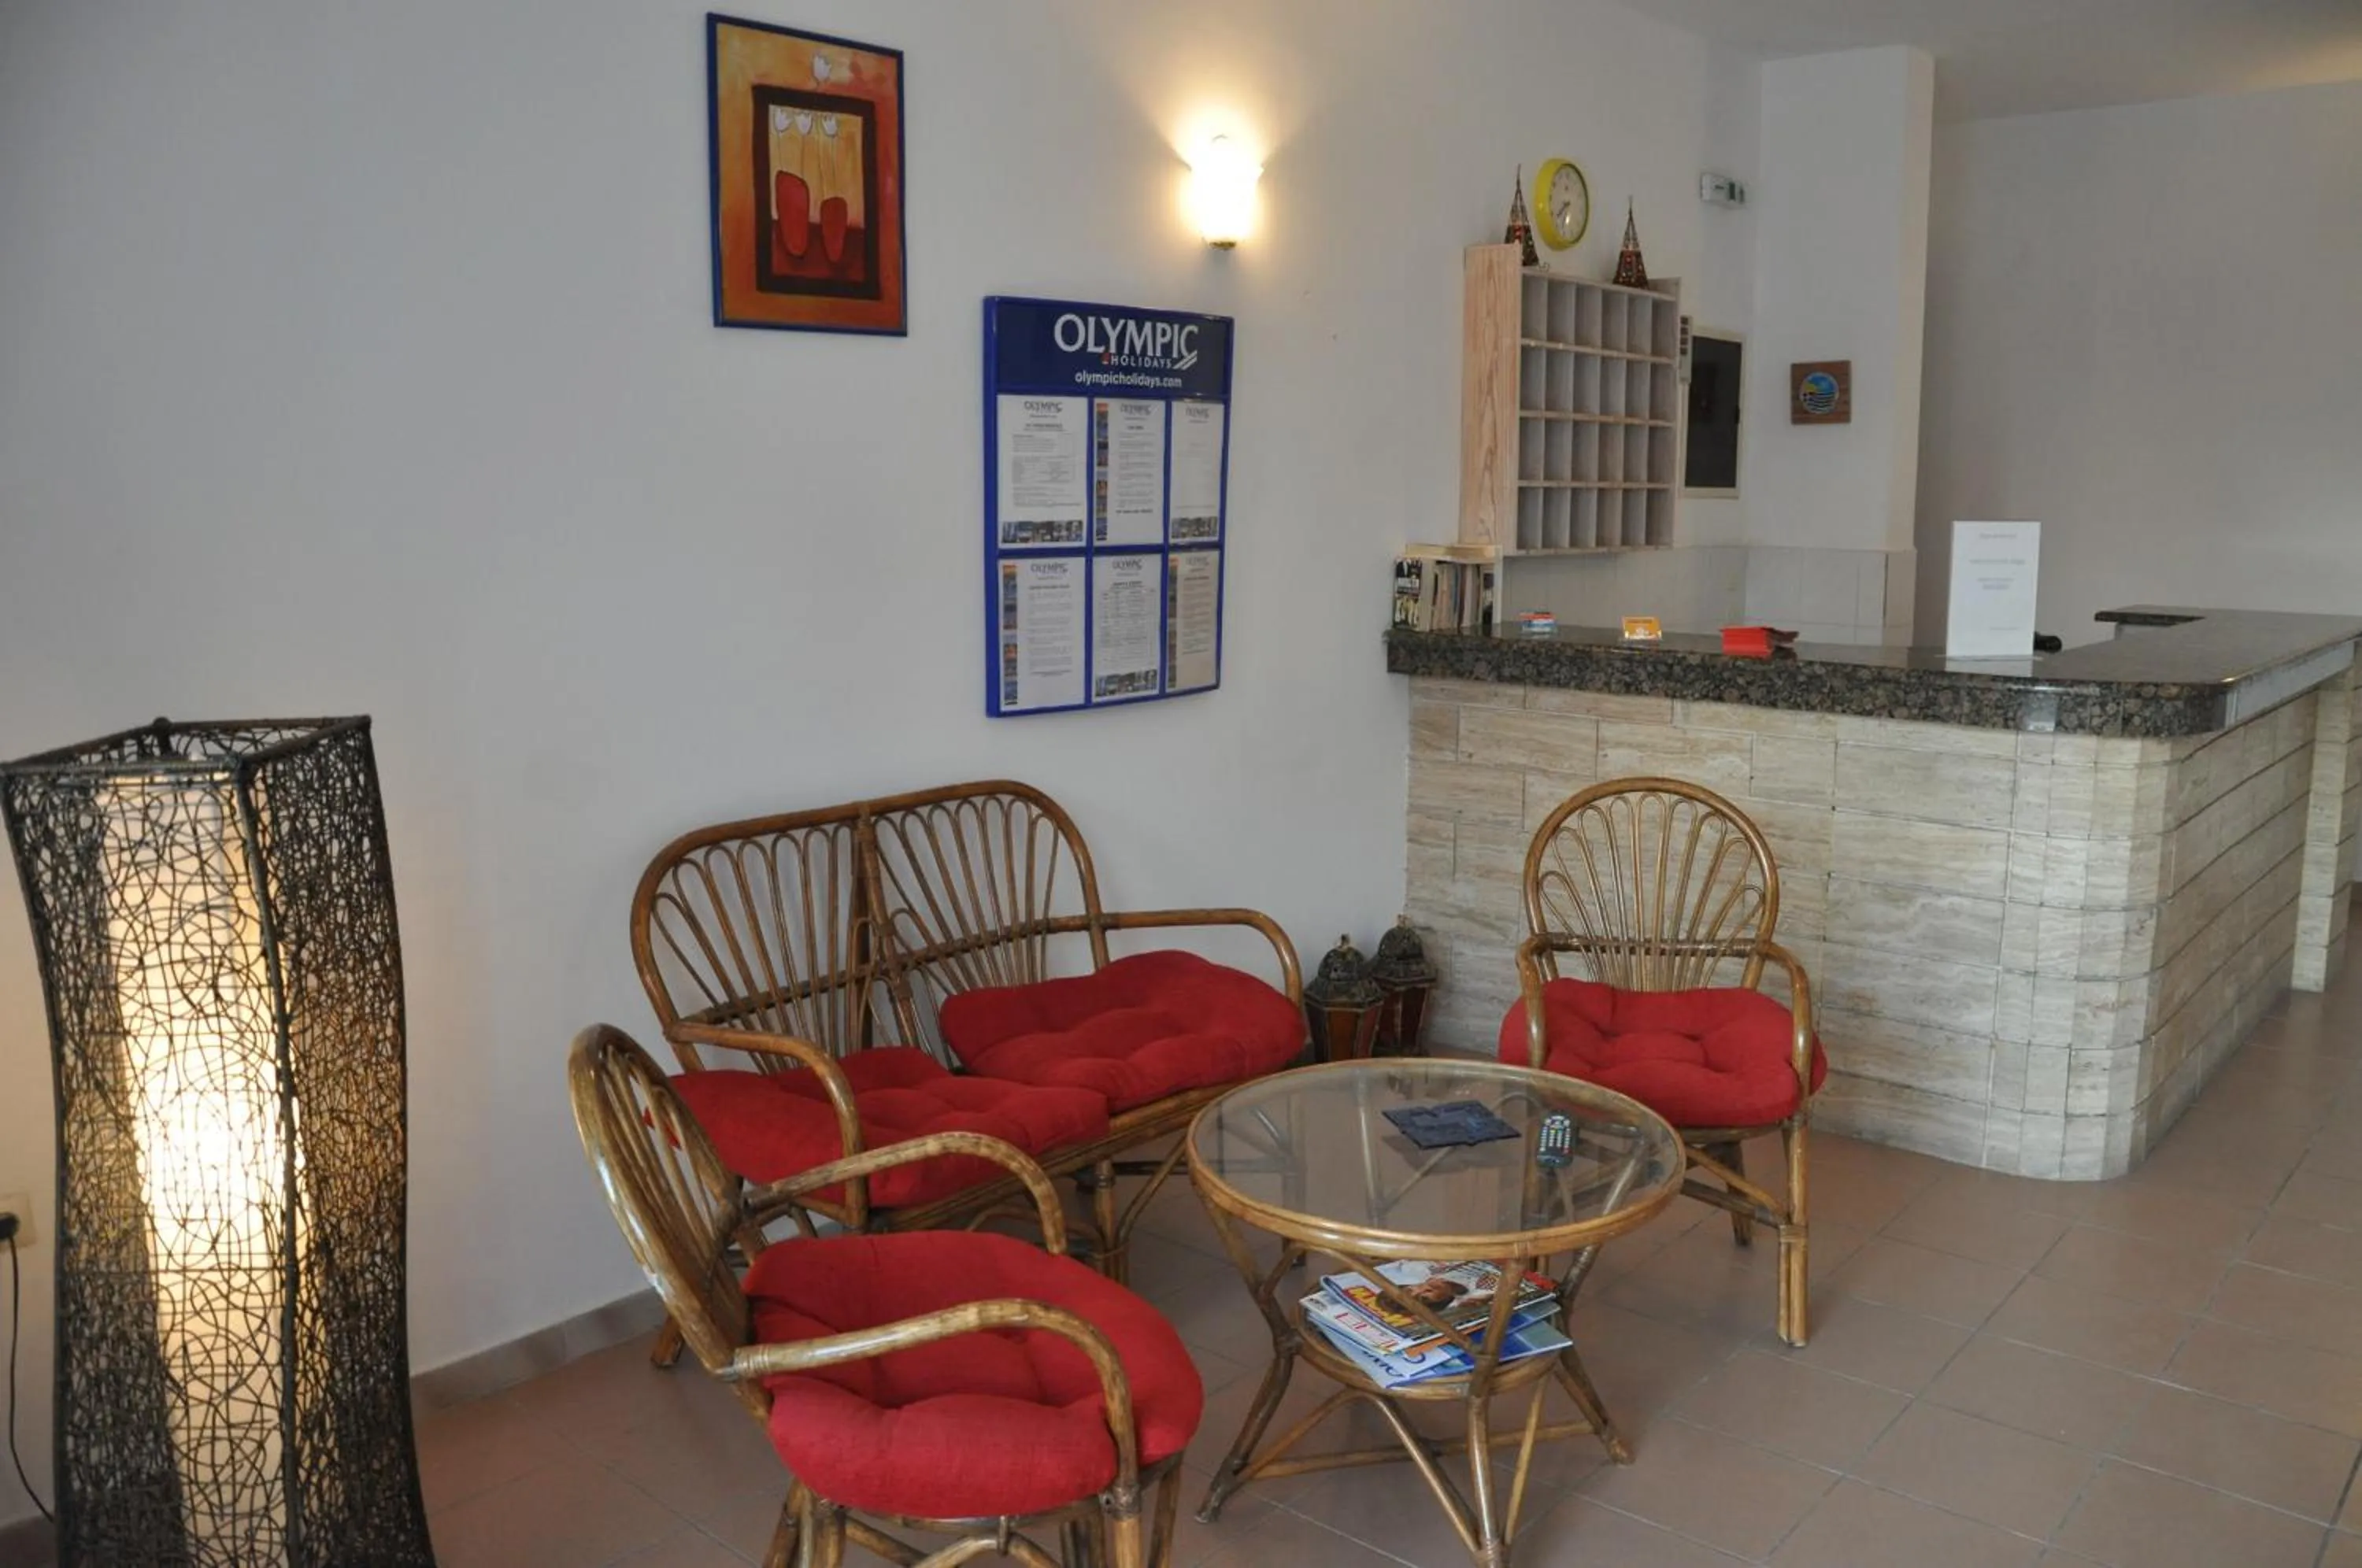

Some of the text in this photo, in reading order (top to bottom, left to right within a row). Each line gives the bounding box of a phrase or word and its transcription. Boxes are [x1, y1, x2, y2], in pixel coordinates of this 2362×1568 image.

[1054, 313, 1198, 359] OLYMPIC
[1111, 355, 1172, 368] HOLIDAYS
[1075, 369, 1182, 388] olympicholidays.com
